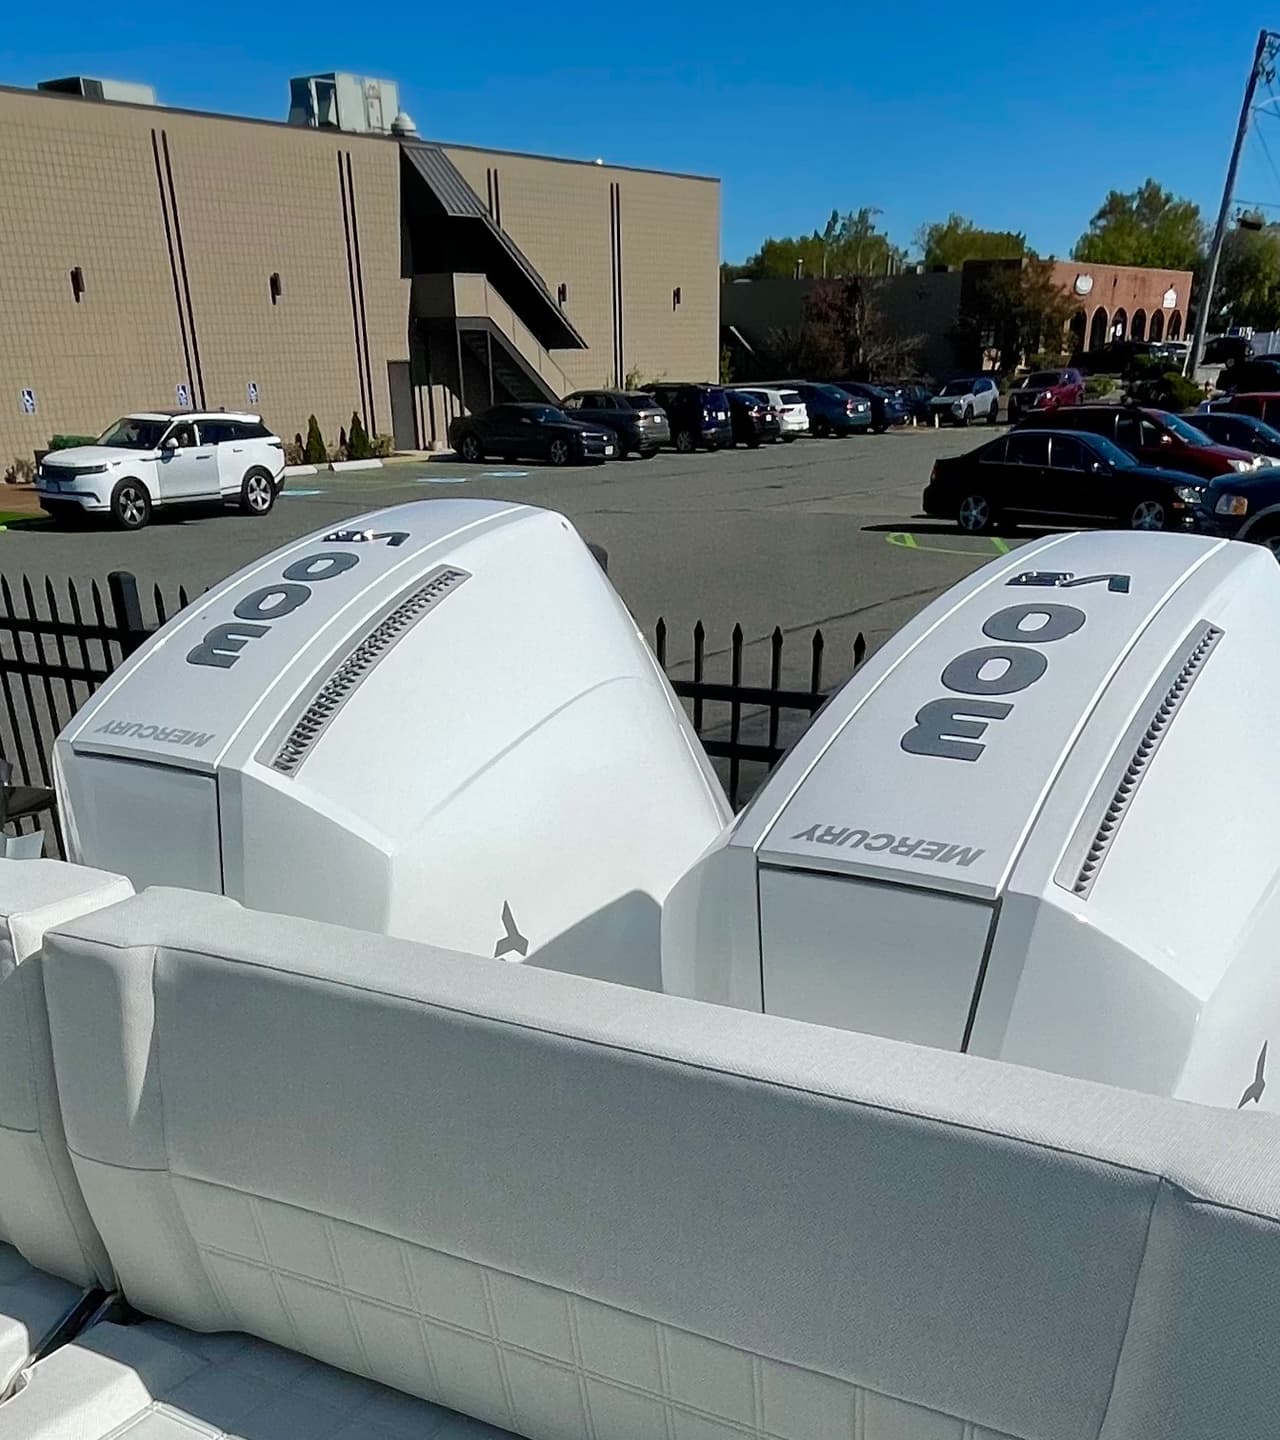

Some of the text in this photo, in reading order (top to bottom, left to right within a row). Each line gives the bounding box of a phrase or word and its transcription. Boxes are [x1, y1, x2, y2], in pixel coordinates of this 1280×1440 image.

[185, 551, 360, 669] 300
[900, 602, 1087, 762] 300
[96, 719, 216, 748] MERCURY
[790, 823, 987, 868] MERCURY
